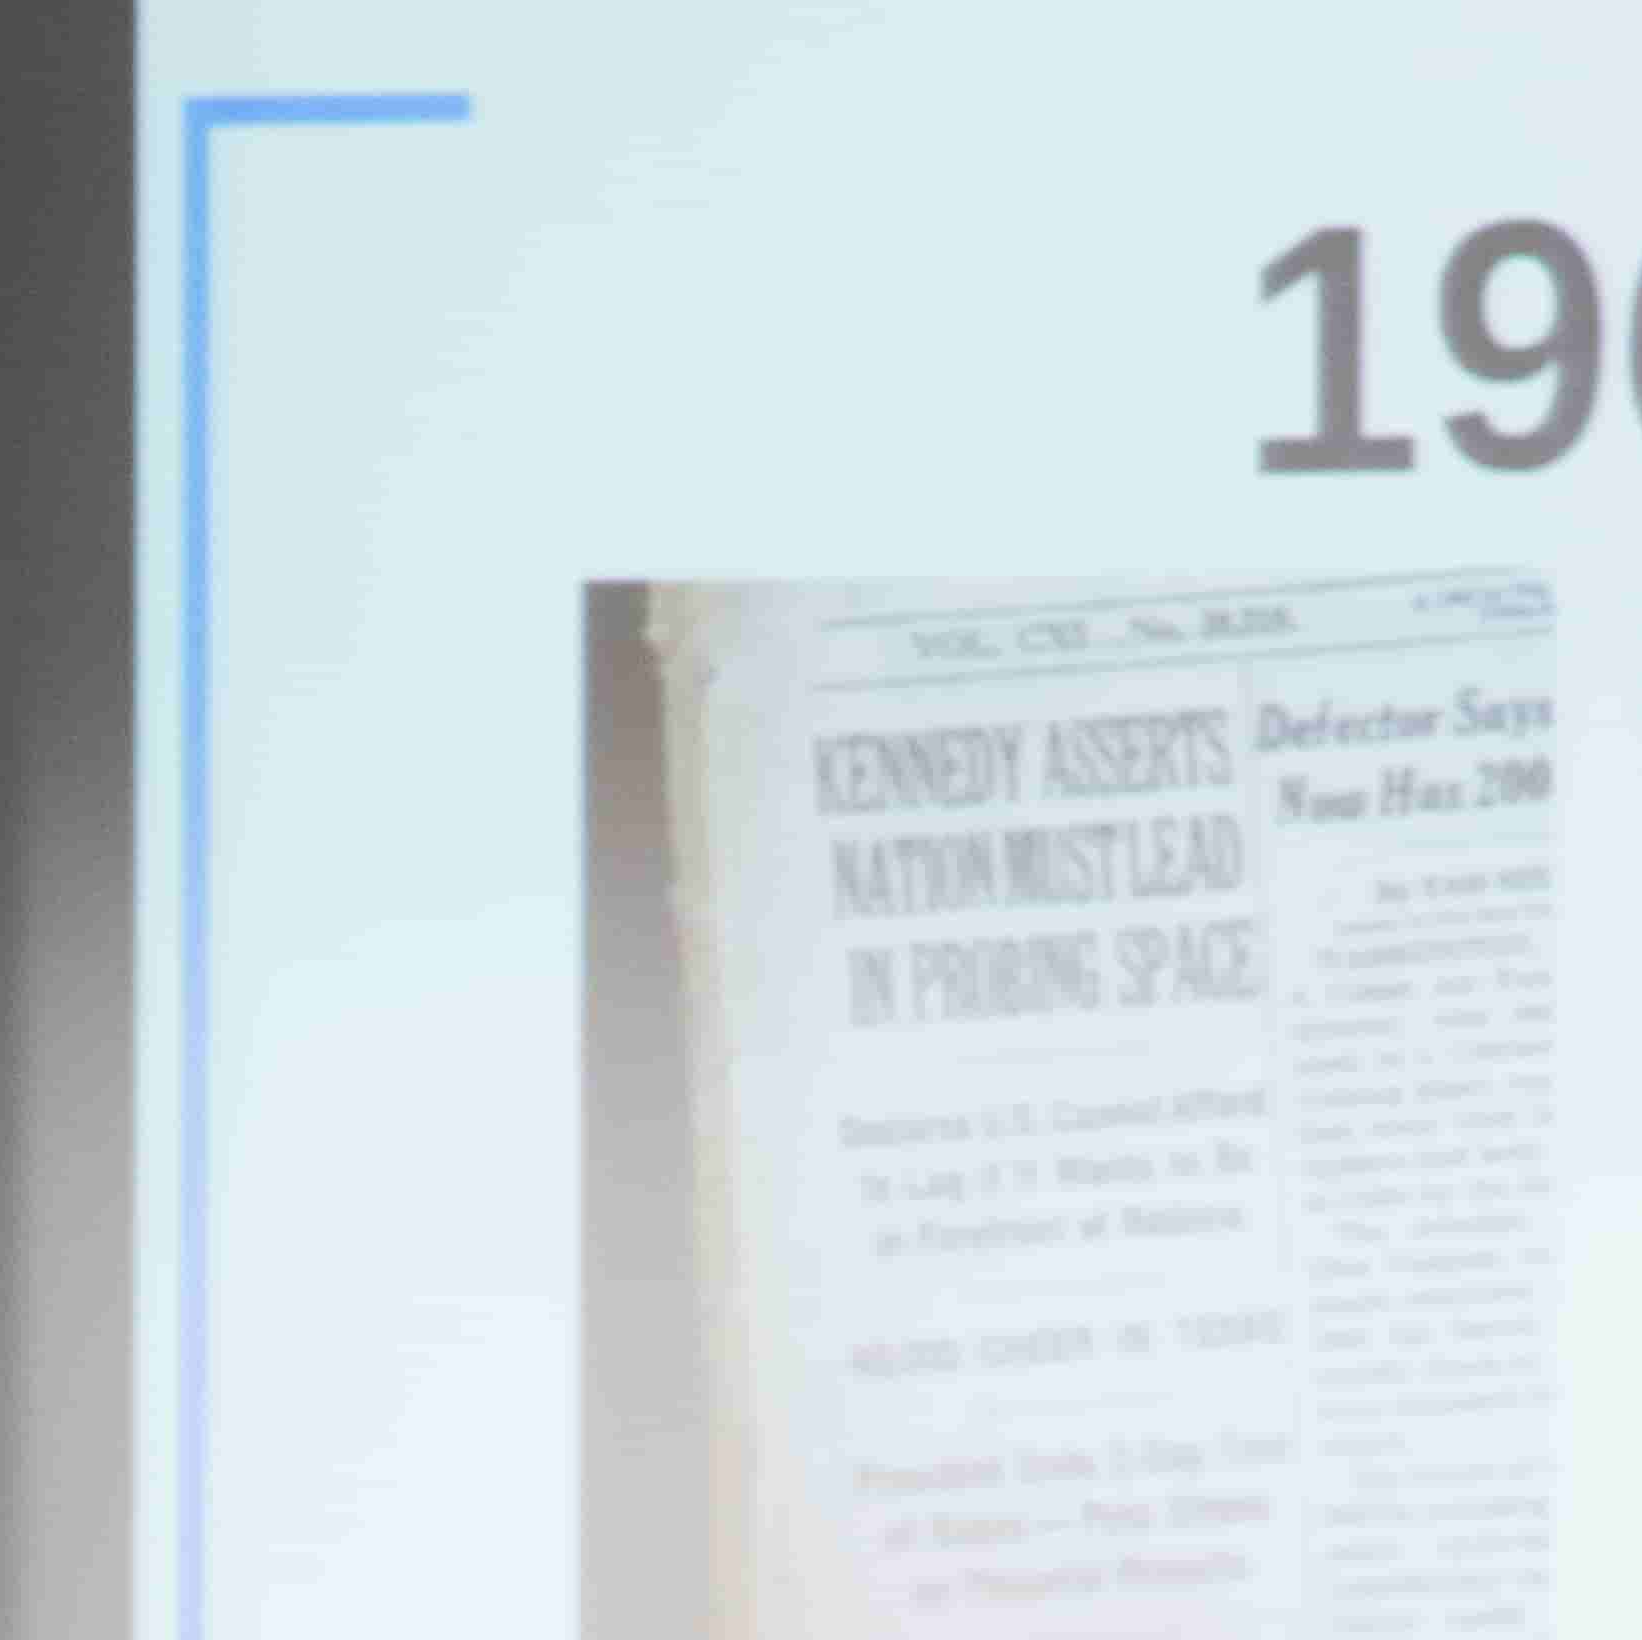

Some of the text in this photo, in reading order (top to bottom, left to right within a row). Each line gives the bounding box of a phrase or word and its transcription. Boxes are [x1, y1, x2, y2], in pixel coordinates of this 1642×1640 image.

[812, 706, 1233, 816] KENNEDY ASSERTS
[1252, 682, 1556, 753] Defector Says
[1378, 763, 1466, 816] Has
[830, 813, 1244, 920] NATION MUST LEAD
[846, 915, 1262, 1028] IN PROBING SPACE
